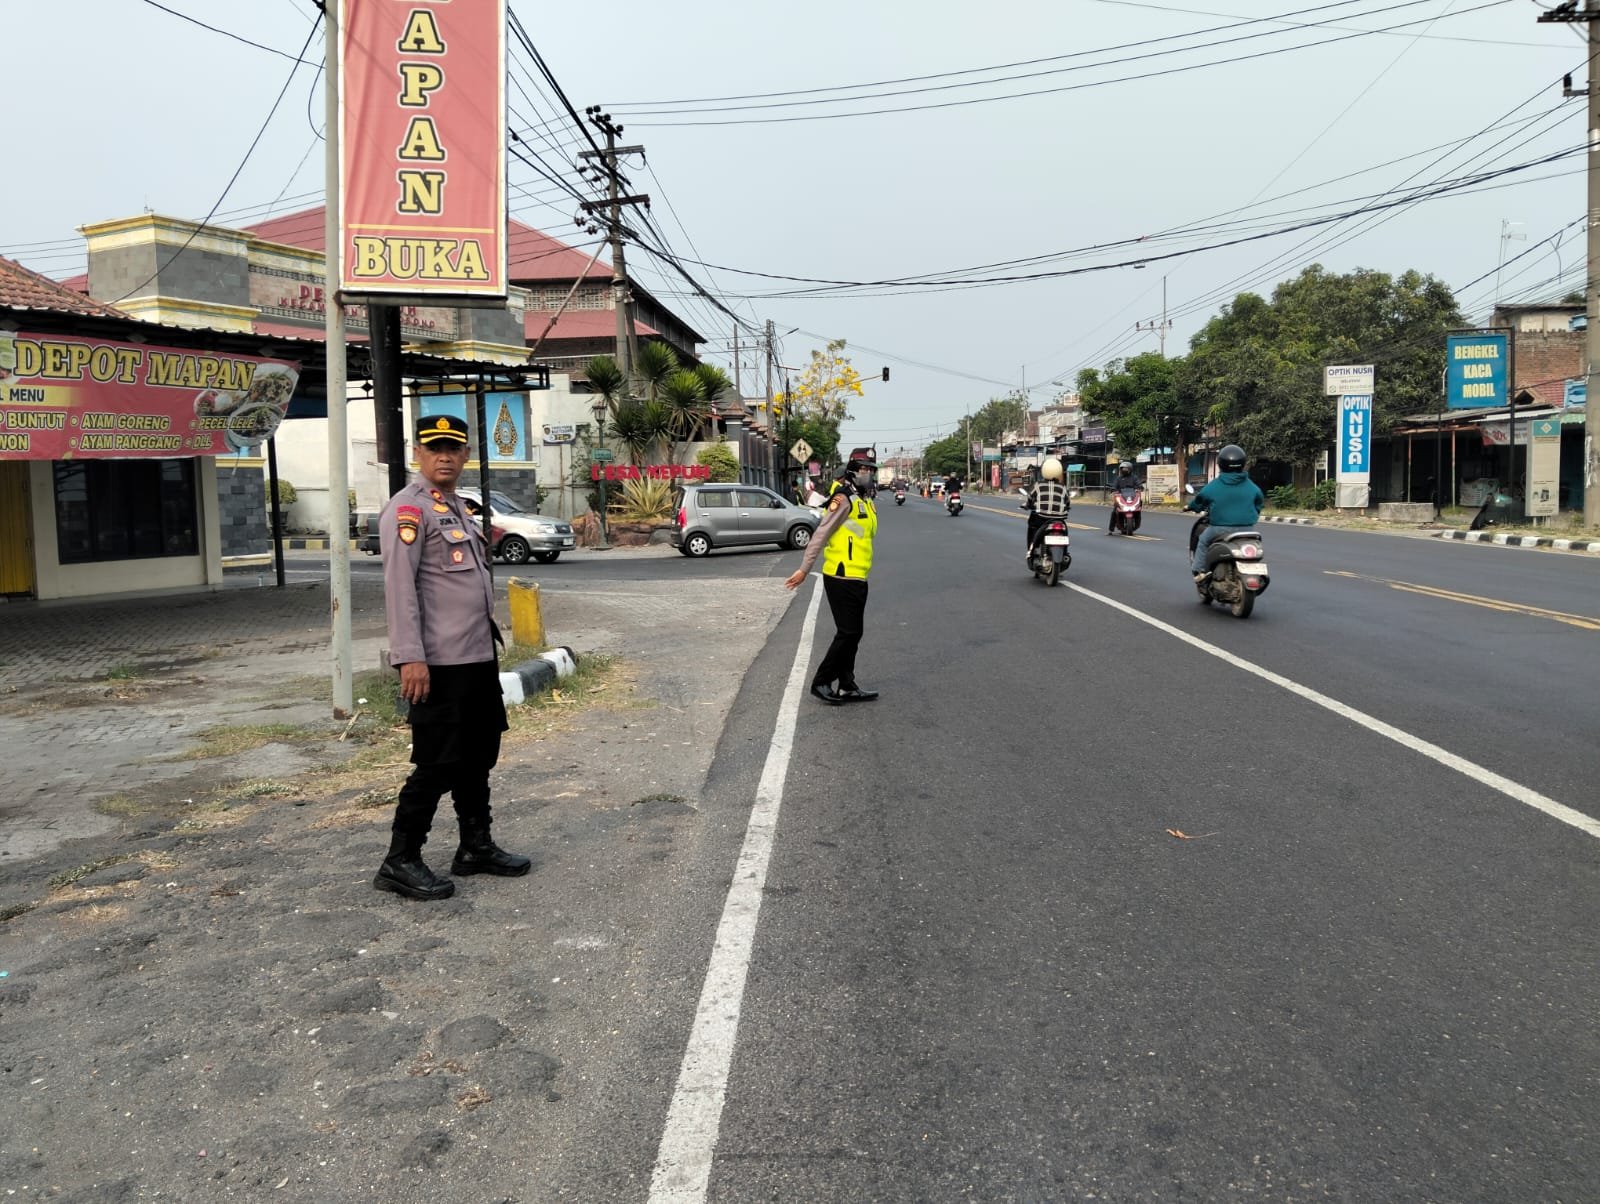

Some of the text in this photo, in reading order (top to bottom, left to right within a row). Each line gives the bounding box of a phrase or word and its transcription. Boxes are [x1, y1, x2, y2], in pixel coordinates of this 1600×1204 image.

[397, 0, 448, 215] APAN
[352, 236, 490, 282] BUKA
[1454, 344, 1499, 360] BENGKEL
[14, 340, 256, 392] DEPOT MAPAN
[1328, 367, 1373, 376] OPTIK NUSA
[1463, 363, 1492, 379] KACA
[9, 388, 45, 402] MENU
[1462, 382, 1496, 399] MOBIL
[1343, 396, 1369, 411] OPTIK
[6, 411, 66, 429] BUNTUT
[81, 414, 116, 430] AYAM
[117, 415, 170, 431] GORENG
[198, 416, 228, 430] PECEL
[229, 416, 256, 430] LELE
[80, 434, 113, 450] AYAM
[115, 435, 181, 451] PANGGANG
[192, 434, 213, 449] DLL
[1348, 411, 1363, 465] NUSA
